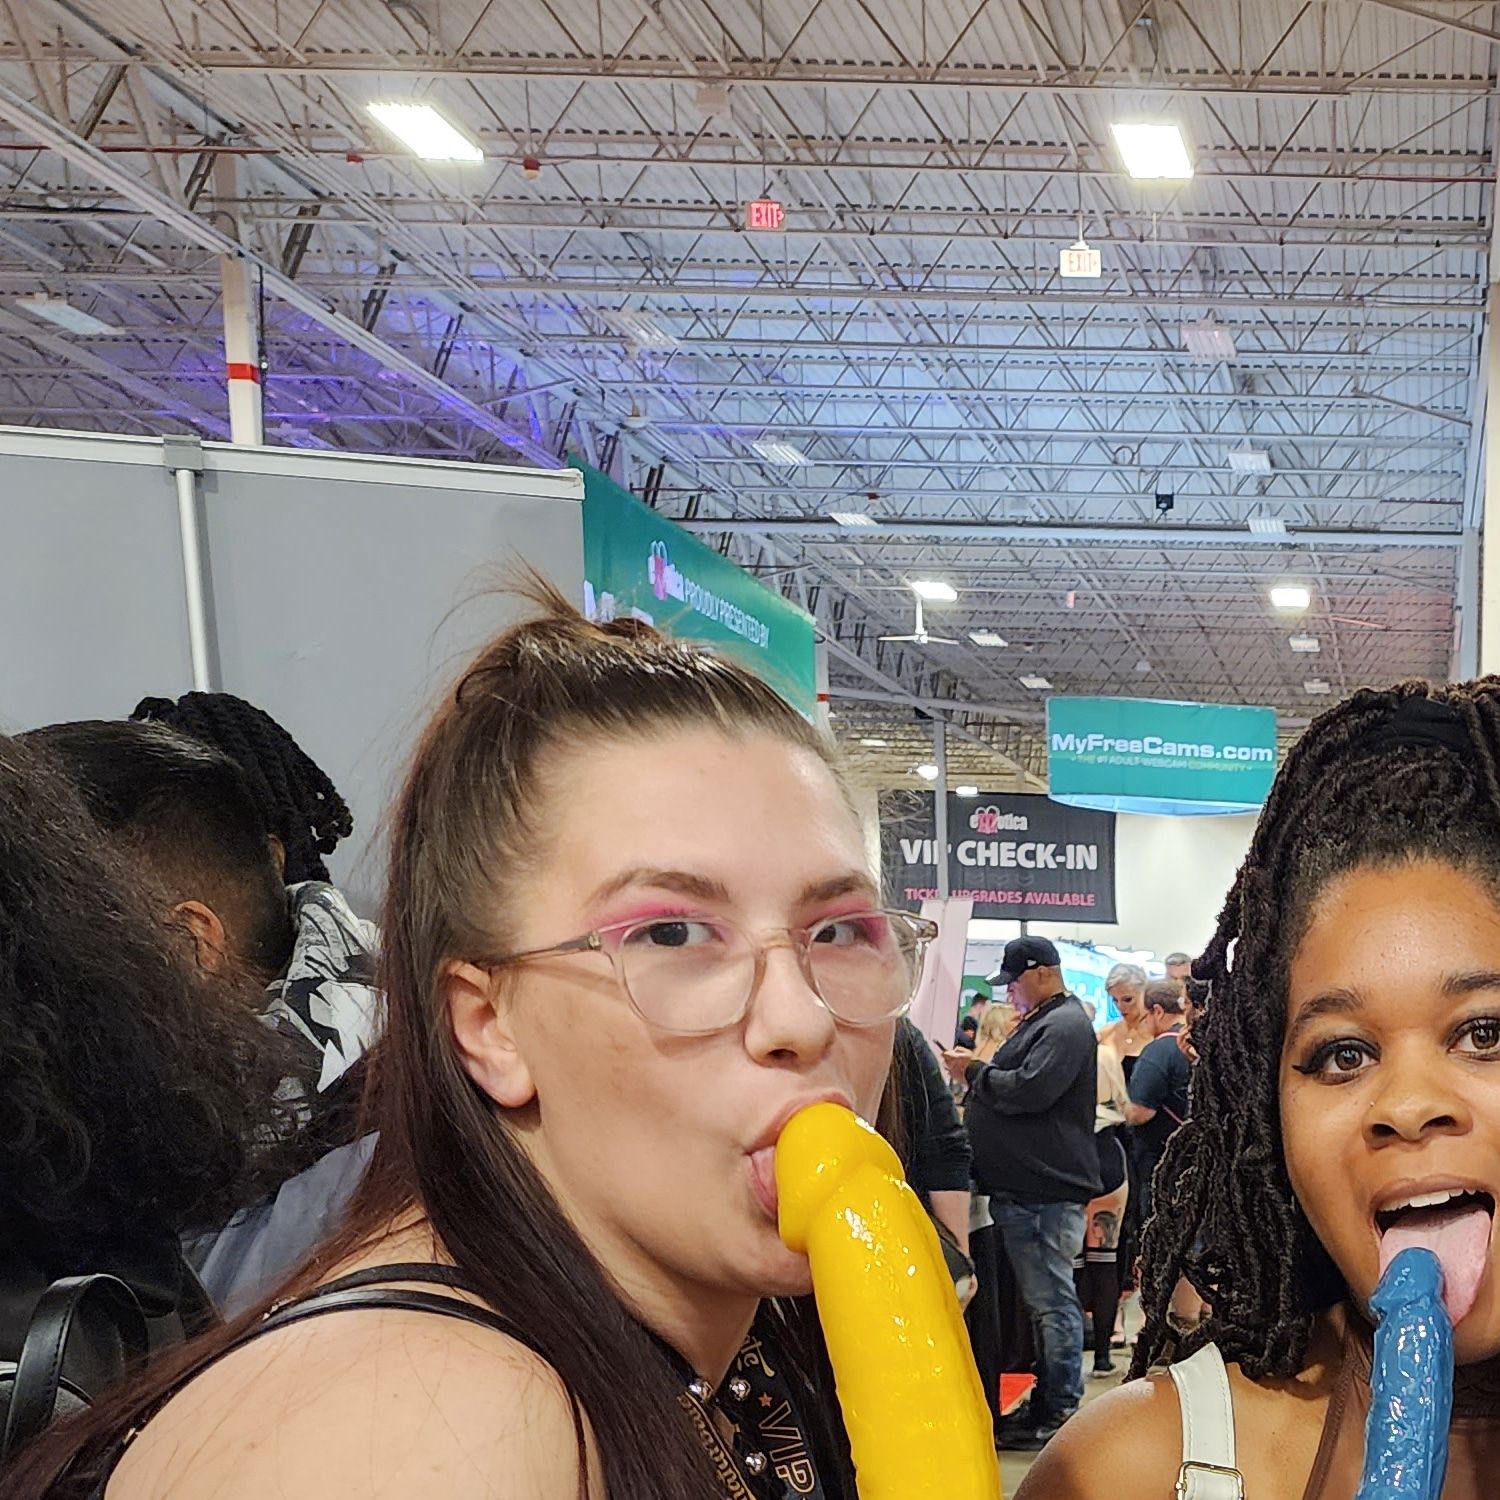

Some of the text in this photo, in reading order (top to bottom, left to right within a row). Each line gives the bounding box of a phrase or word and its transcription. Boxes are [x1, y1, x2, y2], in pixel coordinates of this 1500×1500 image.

[751, 203, 780, 228] EXIT
[1069, 253, 1092, 272] EXIT
[685, 577, 719, 620] PROUDLY
[719, 599, 760, 644] PRESENTED
[759, 623, 769, 649] BY
[1052, 733, 1273, 762] MyFreeCams.com
[1109, 755, 1140, 766] ADULT
[956, 840, 1098, 870] CHECK-IN
[904, 888, 1095, 907] TICK UPGRADES AVAILABLE
[759, 1400, 815, 1493] VIP
